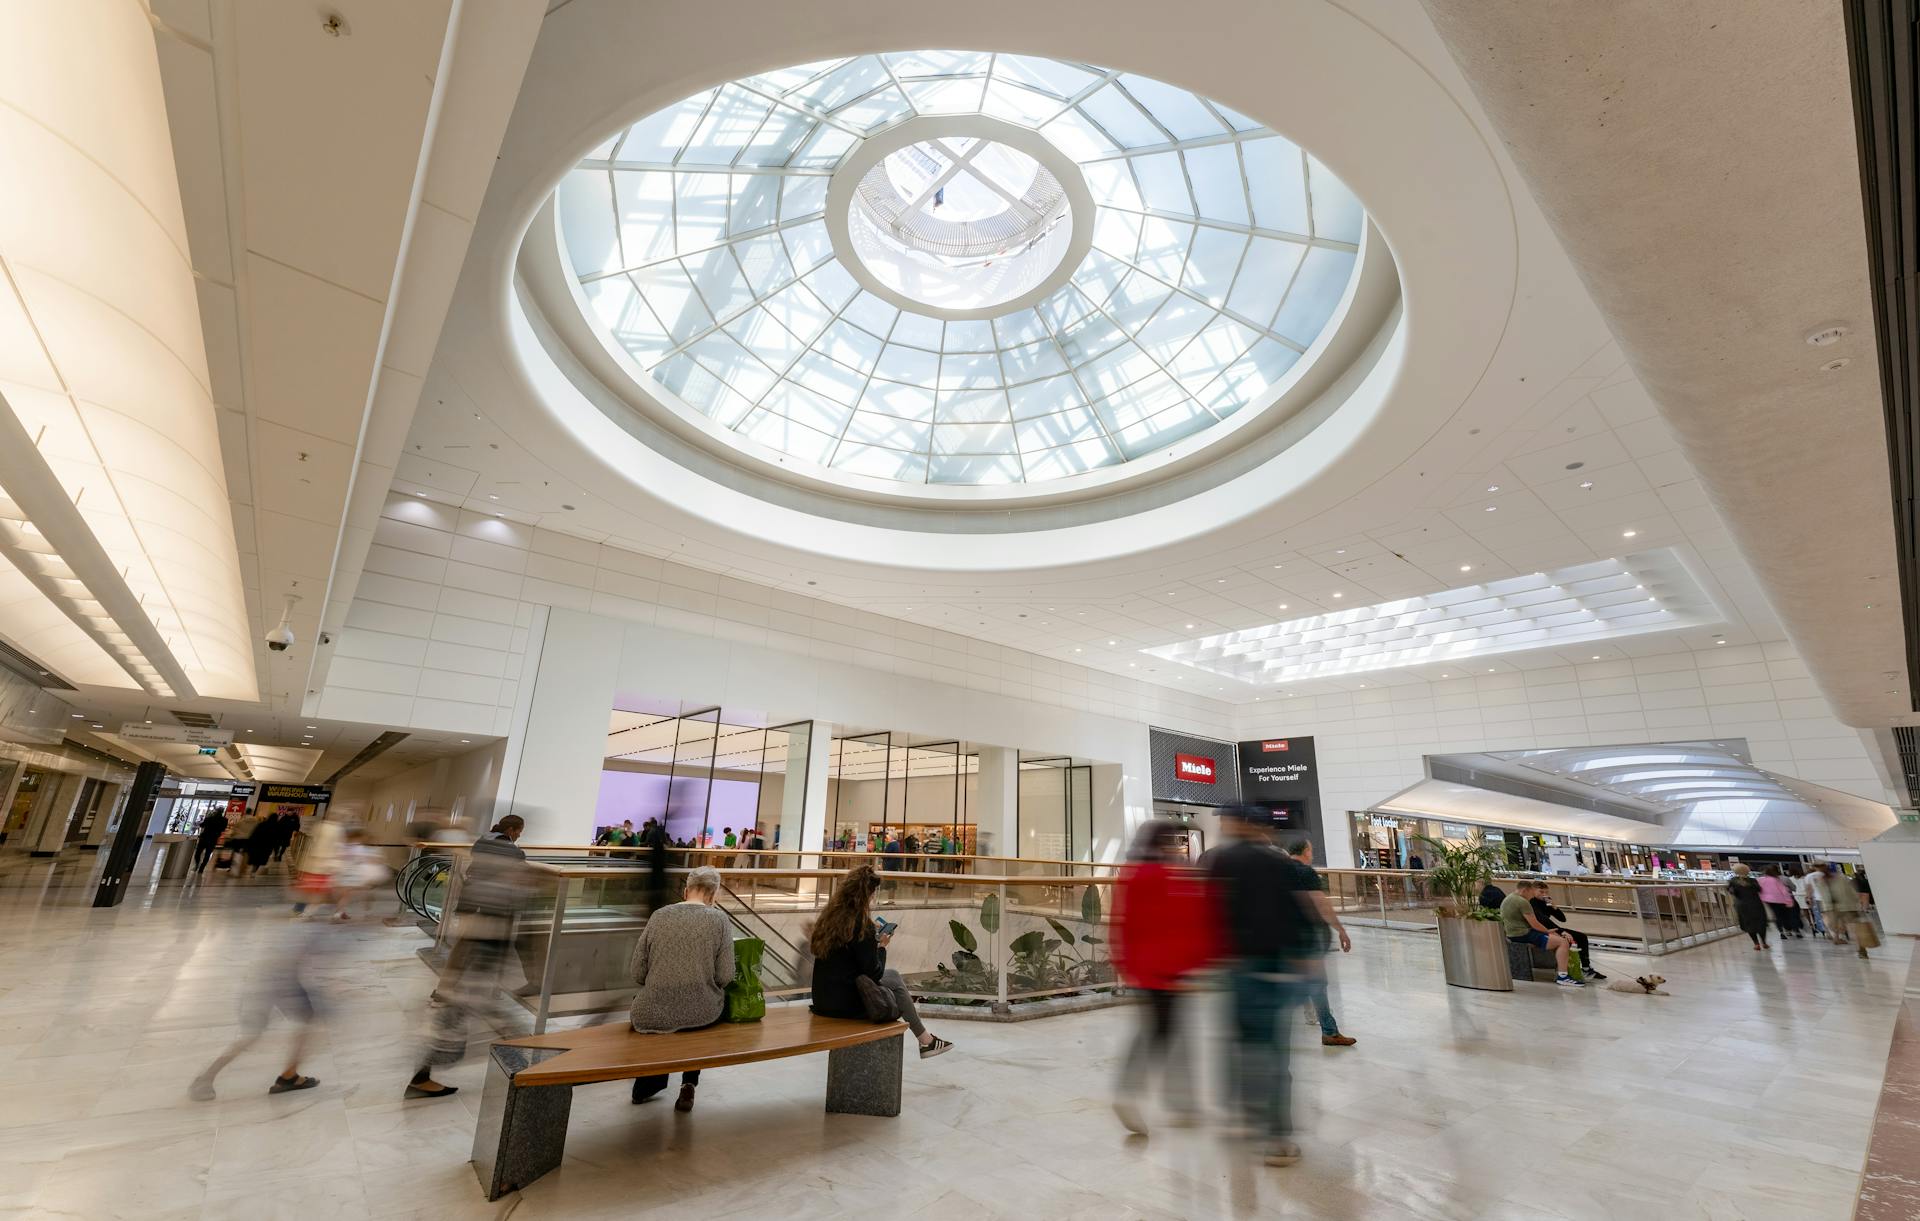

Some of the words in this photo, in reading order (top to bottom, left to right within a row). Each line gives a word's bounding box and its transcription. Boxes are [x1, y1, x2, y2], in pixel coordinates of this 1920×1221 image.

[1181, 761, 1212, 776] Miele
[1249, 765, 1286, 774] Experience
[1287, 764, 1308, 772] Miele
[1271, 773, 1299, 781] Yourself
[267, 791, 309, 799] WAREHOUS
[1370, 813, 1382, 827] Foot
[1382, 816, 1399, 828] Locker
